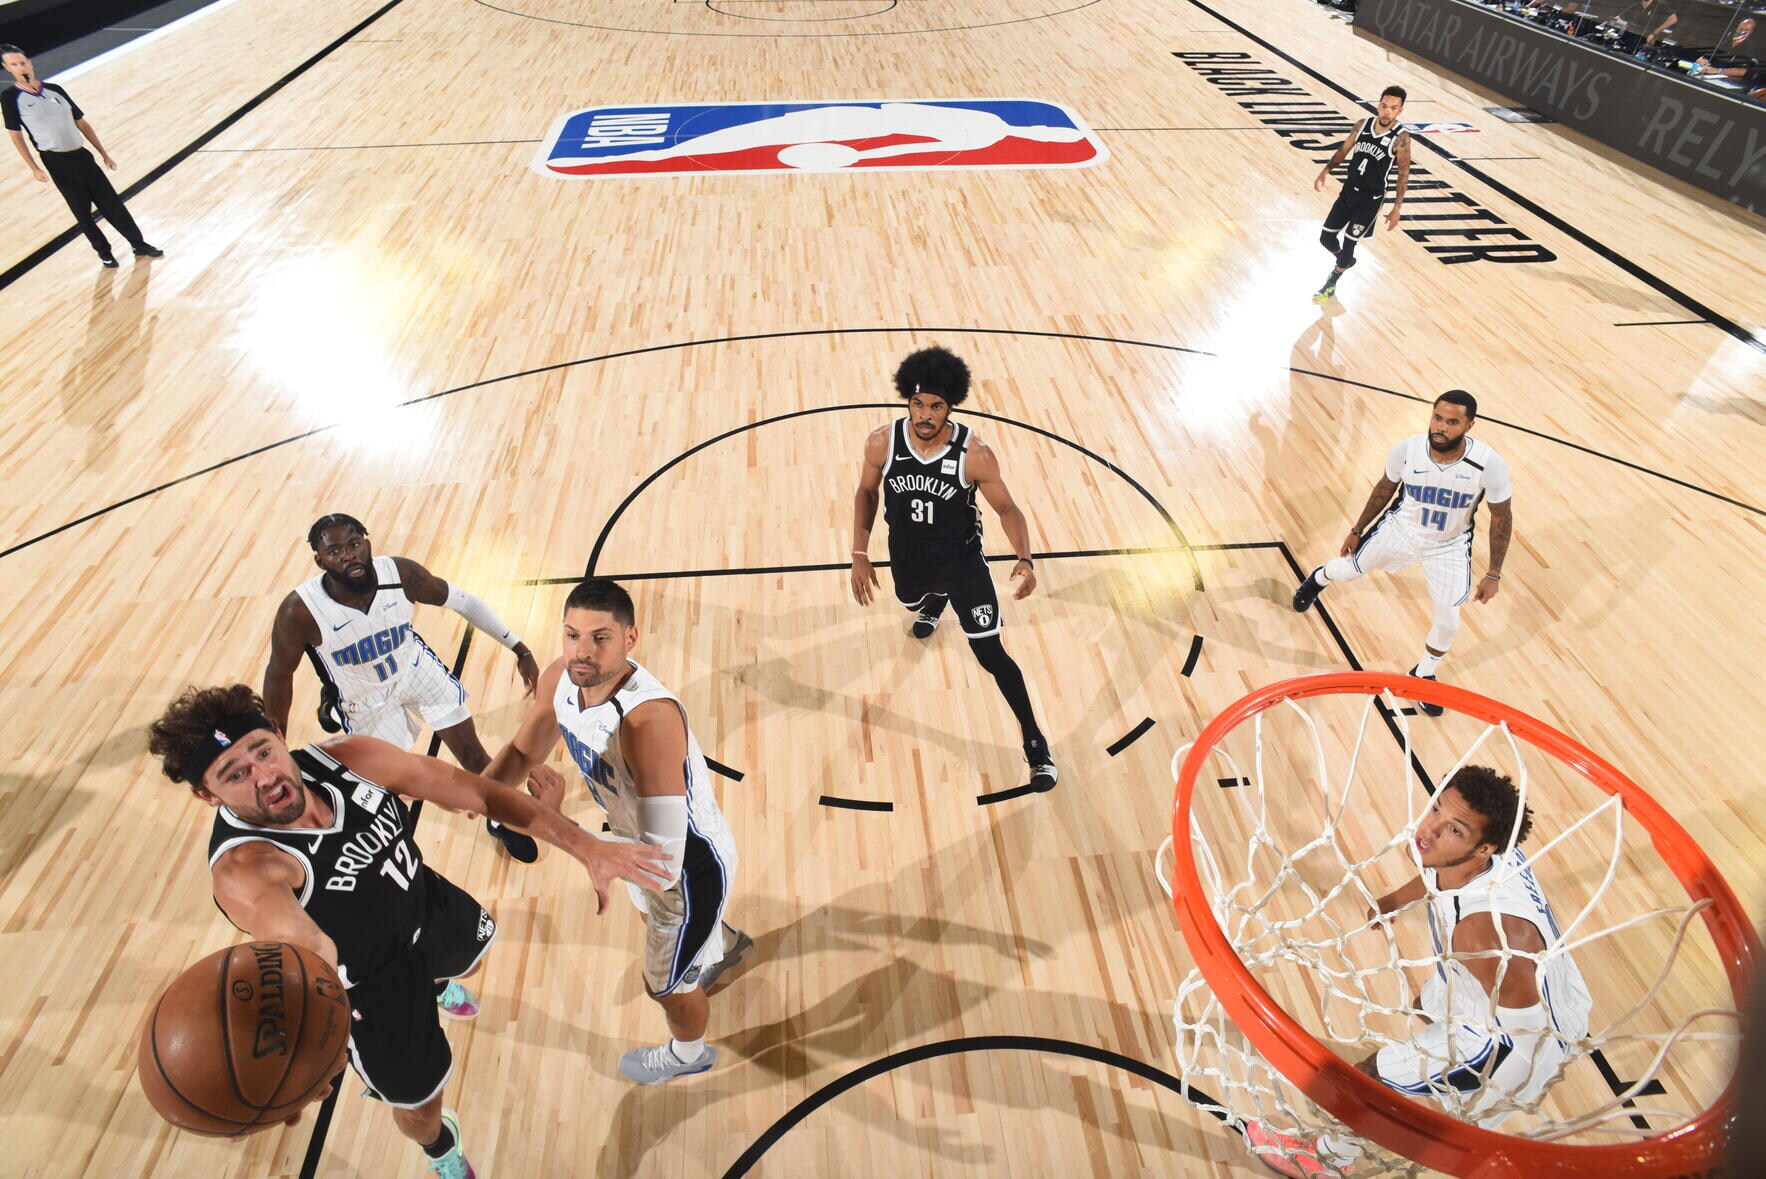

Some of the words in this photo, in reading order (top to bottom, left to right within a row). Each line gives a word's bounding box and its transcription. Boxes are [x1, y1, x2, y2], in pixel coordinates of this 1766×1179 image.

[1171, 52, 1312, 96] BLACK
[1376, 0, 1461, 58] QATAR
[1456, 25, 1612, 120] AIRWAYS
[581, 113, 671, 149] NBA
[1637, 95, 1766, 187] RELY
[1358, 158, 1369, 176] 4
[889, 474, 957, 500] BROOKLYN
[1404, 484, 1475, 509] MAGIC
[911, 499, 934, 524] 31
[1421, 507, 1448, 531] 14
[973, 605, 992, 617] NETS
[331, 622, 410, 666] MAGIC
[373, 653, 398, 683] 11
[361, 788, 375, 808] nfor
[325, 796, 403, 891] BROOKLY
[380, 839, 419, 892] 12
[250, 943, 288, 1059] SPALDING
